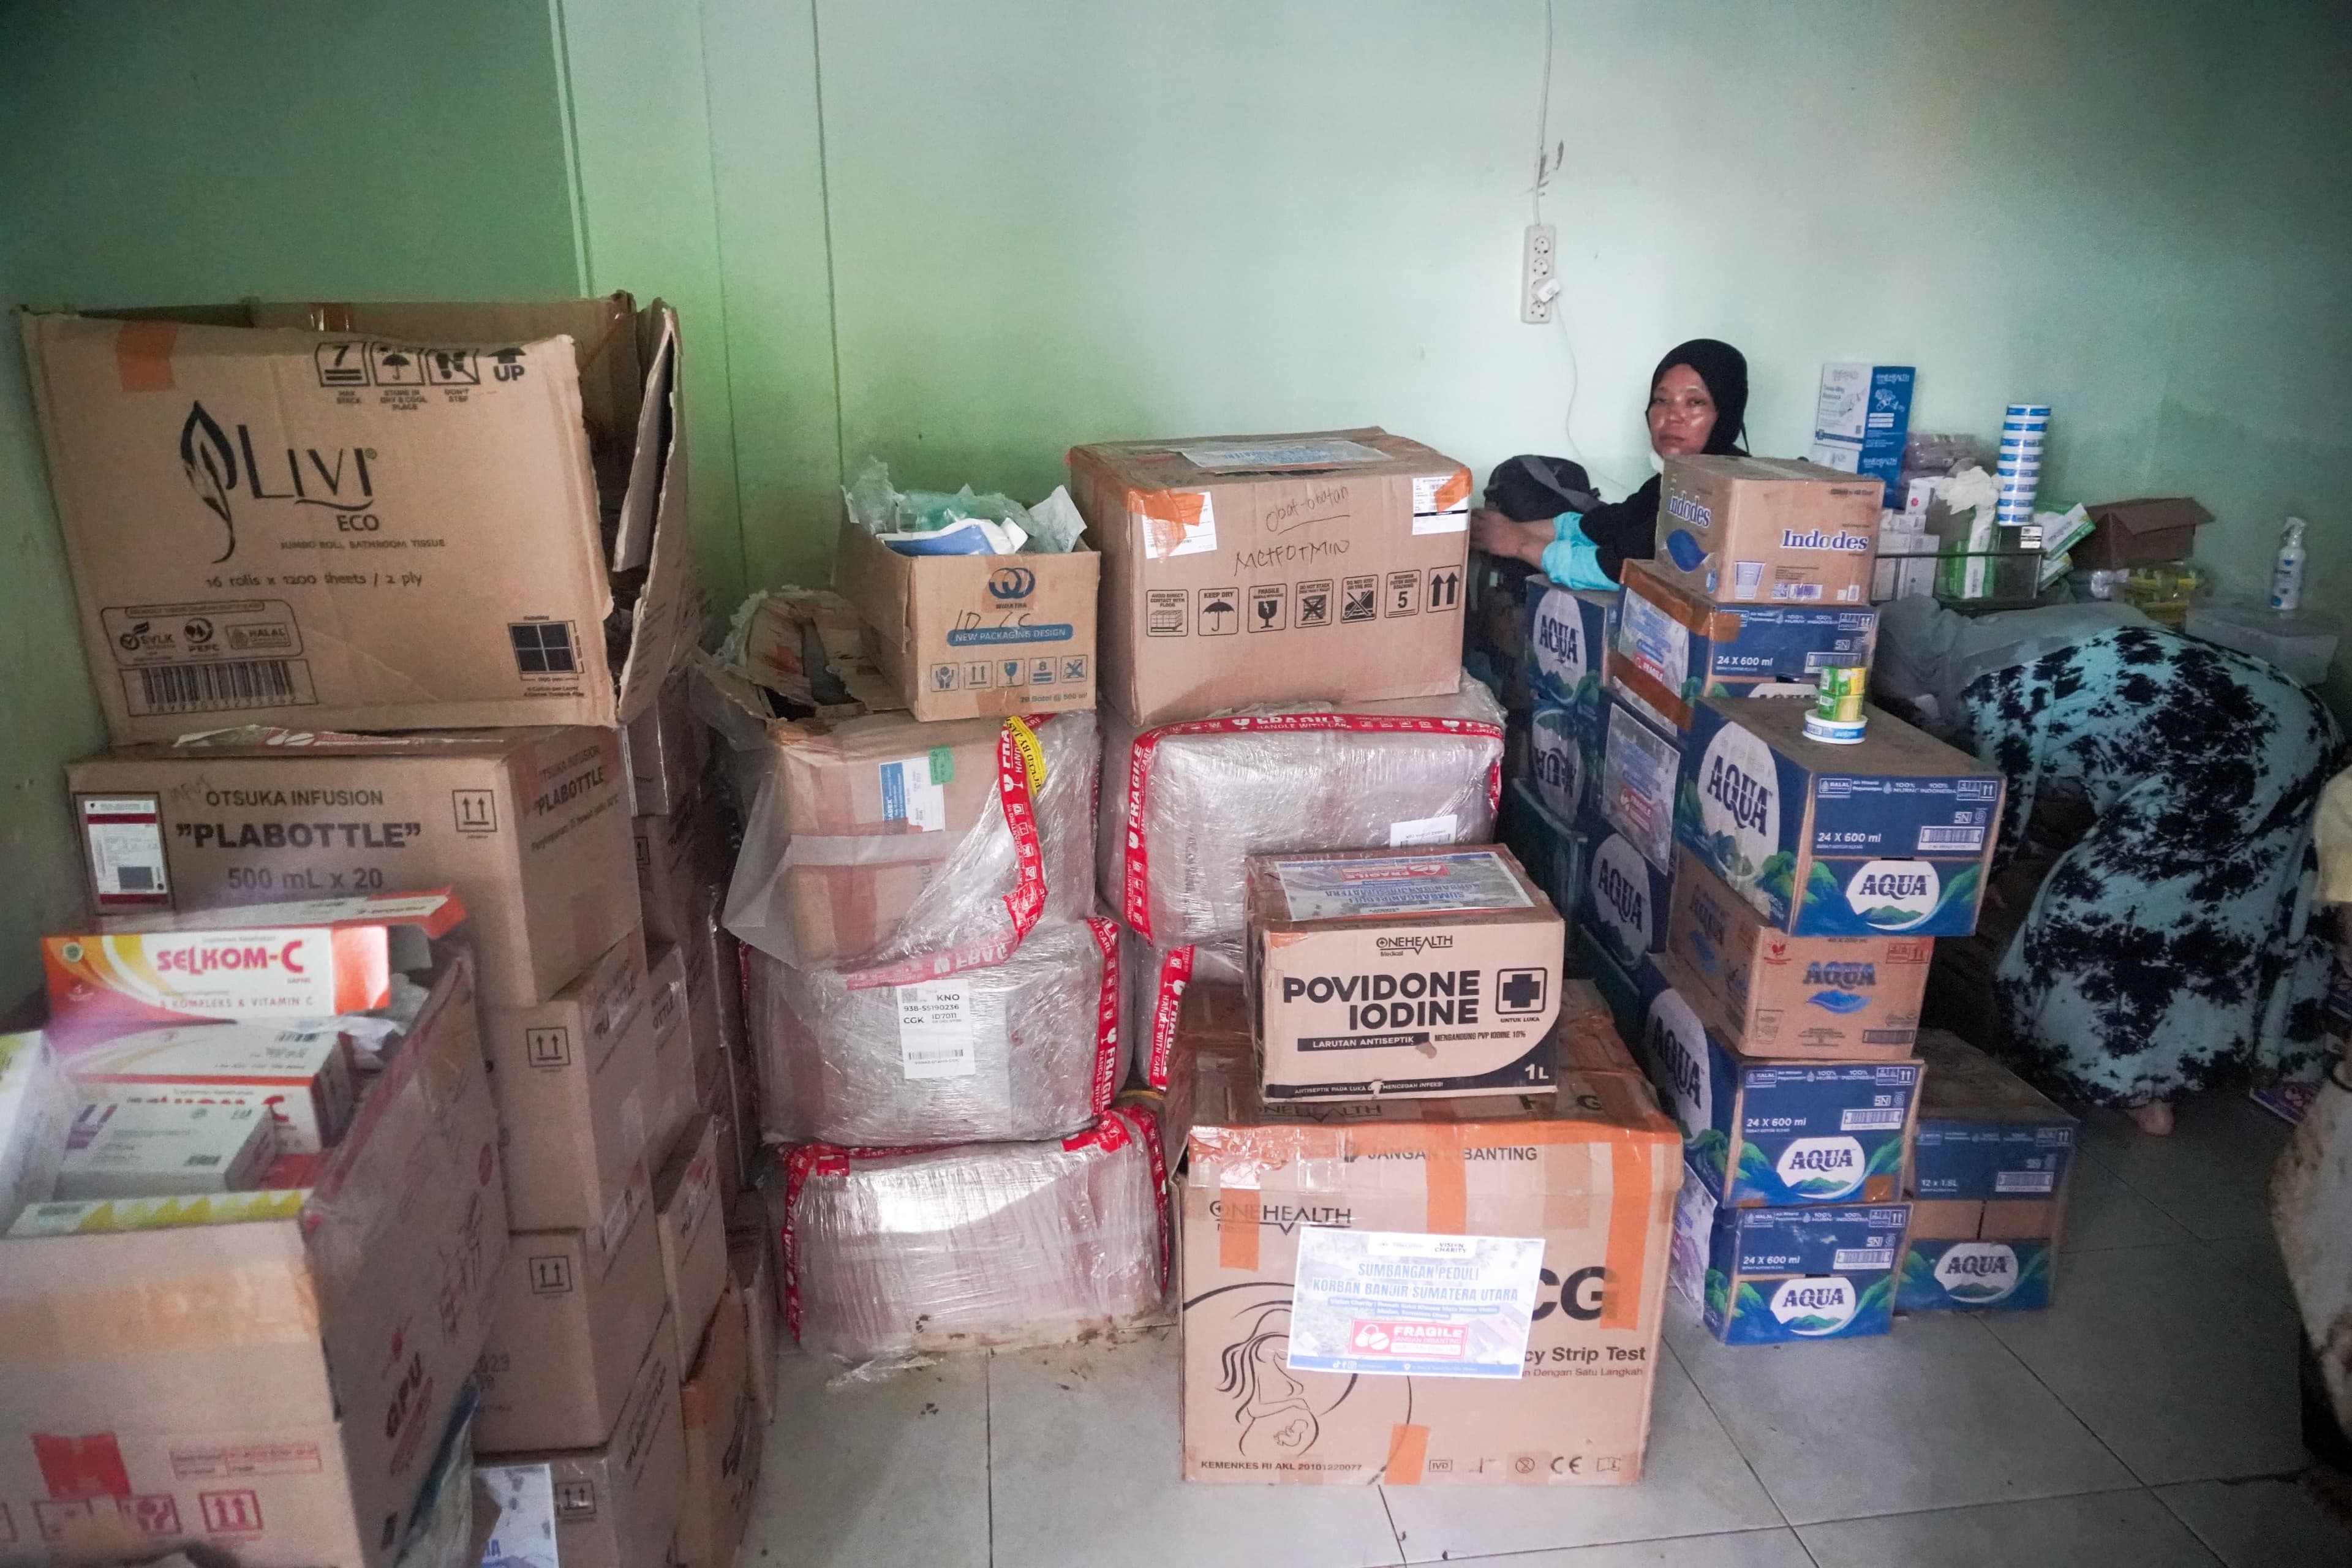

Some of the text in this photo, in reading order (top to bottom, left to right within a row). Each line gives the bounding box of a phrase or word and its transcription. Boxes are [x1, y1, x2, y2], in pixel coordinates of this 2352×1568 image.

[493, 366, 525, 382] UP
[336, 514, 379, 532] ECO
[411, 539, 445, 548] TISSUE
[1782, 529, 1869, 550] Indodes
[230, 574, 260, 586] rolls
[282, 575, 317, 584] 1200
[325, 572, 366, 584] sheets
[386, 575, 395, 584] 2
[402, 571, 422, 586] ply
[1398, 591, 1408, 608] 5
[956, 628, 1066, 642] NEW PACKAGING DESIGN
[1539, 614, 1578, 664] AQUA
[1717, 656, 1729, 665] 24
[1741, 657, 1759, 665] 600
[1762, 657, 1773, 666] ml
[1140, 747, 1152, 772] CARE
[1128, 743, 1143, 824] FRAGILE
[206, 790, 383, 806] OTSUKA INFUSION
[1707, 755, 1768, 837] AQUA
[1818, 833, 1882, 842] 24 X 600 ml
[228, 868, 273, 890] 500
[282, 867, 321, 889] mL
[353, 867, 383, 889] 20
[1859, 874, 1928, 900] AQUA
[1598, 858, 1643, 933] AQUA
[1376, 935, 1453, 950] ONEHEALTH
[1803, 961, 1875, 989] AQUA
[1283, 970, 1480, 1003] POVIDONE
[252, 997, 300, 1006] VITAMIN
[306, 996, 314, 1005] C
[1158, 995, 1169, 1030] HANDLE
[1349, 998, 1479, 1030] IODINE
[1154, 1030, 1164, 1054] WITH
[1313, 1036, 1414, 1048] LARUTAN ANTISEPTIK
[1434, 1033, 1476, 1041] MENGANDUNG
[1655, 1015, 1702, 1109] AQUA
[1102, 1047, 1117, 1111] FRAGIL
[1525, 1064, 1549, 1080] 1L
[1771, 1118, 1792, 1126] 600
[1794, 1117, 1806, 1126] ml
[1368, 1146, 1538, 1161] JANGA BANTING
[1789, 1149, 1853, 1175] AQUA
[1743, 1256, 1755, 1265] 24
[1767, 1256, 1787, 1264] 600
[1789, 1256, 1800, 1264] ml
[1945, 1256, 2008, 1276] AQUA
[1359, 1262, 1479, 1281] SUMBANGAN PEDULI
[1313, 1278, 1518, 1302] KORBAN BANJIR SUMATERA UTARA
[1781, 1288, 1845, 1311] AQUA
[1394, 1326, 1463, 1338] FRAGILE
[1552, 1347, 1599, 1365] Strip
[1606, 1346, 1646, 1361] Test
[1534, 1368, 1572, 1378] Dengan
[1600, 1368, 1643, 1378] Langkah
[1201, 1461, 1259, 1470] KEMENKES
[1262, 1461, 1273, 1470] RI
